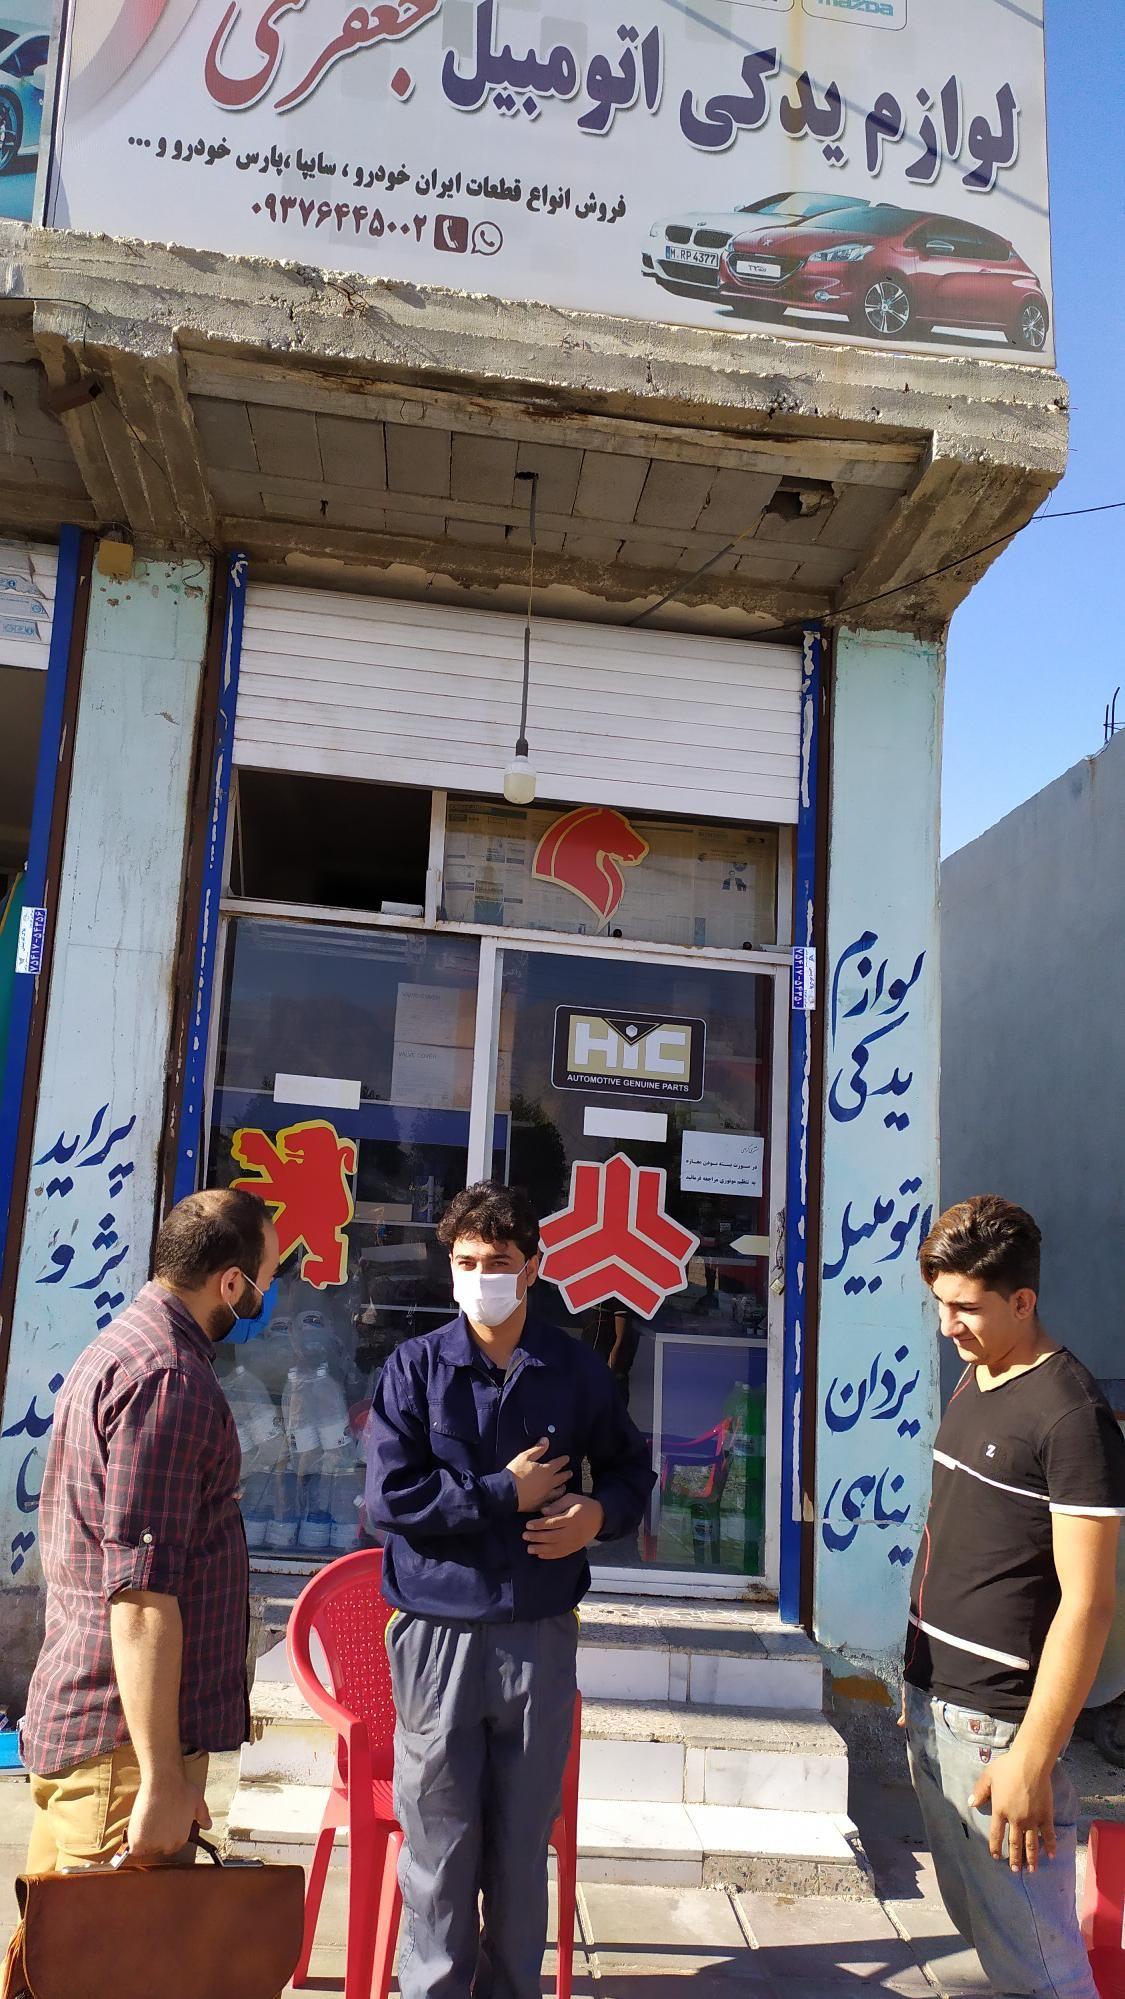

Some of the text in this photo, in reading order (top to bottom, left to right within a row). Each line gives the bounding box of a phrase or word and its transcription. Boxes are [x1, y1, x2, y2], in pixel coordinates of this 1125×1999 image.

[443, 0, 660, 130] اتومبیل
[680, 47, 845, 163] یدکی
[156, 137, 167, 158] و
[866, 75, 1019, 189] لوازم
[171, 137, 231, 166] خودرو
[296, 148, 337, 180] سایپا
[352, 163, 411, 191] خودرو
[415, 168, 462, 199] ایران
[466, 176, 521, 202] قطعات
[526, 184, 571, 215] انواع
[575, 192, 626, 223] فروش
[251, 193, 427, 243] ۰۹۳۷۶۴۴۵۰۰۲
[692, 251, 717, 264] 4377
[831, 930, 926, 1054] لوازم
[567, 1074, 689, 1092] AUTOMOTIVE GENUINE PARTS
[828, 1011, 913, 1132] یدکی
[33, 1102, 136, 1200] پراید
[35, 1212, 130, 1332] پژو
[824, 1344, 921, 1439] یزدان
